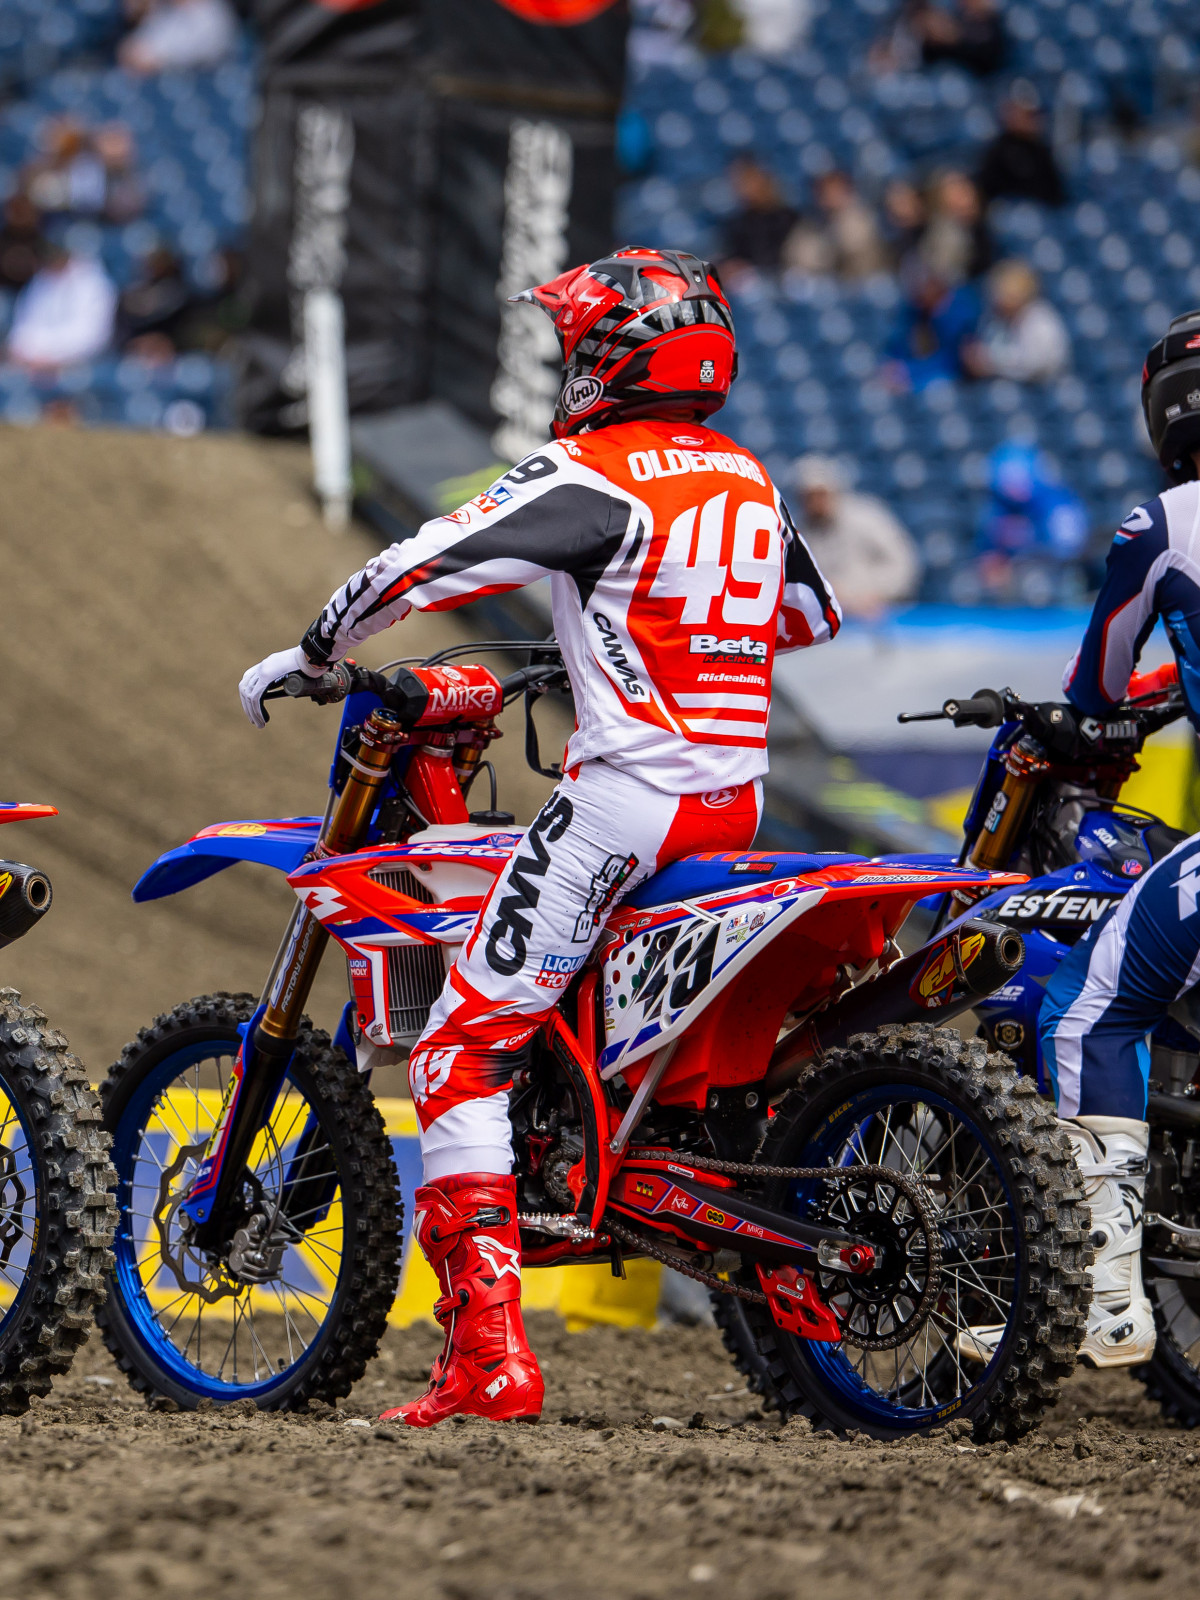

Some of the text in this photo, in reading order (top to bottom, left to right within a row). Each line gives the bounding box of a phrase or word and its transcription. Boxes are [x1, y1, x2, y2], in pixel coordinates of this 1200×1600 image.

[700, 369, 715, 378] DOT
[567, 380, 596, 407] Arai
[502, 455, 559, 484] 9
[627, 448, 766, 488] OLDENBURG
[649, 490, 783, 626] 49
[593, 612, 645, 697] CANVAS
[690, 634, 768, 655] Beta
[704, 654, 754, 664] RACING
[696, 673, 766, 687] Rideability
[1123, 858, 1139, 874] VP
[281, 963, 302, 1013] FACTORY
[298, 916, 318, 963] SUSPEN
[349, 960, 367, 968] LIQUI
[350, 968, 367, 976] MOLY
[920, 932, 986, 997] FMF
[408, 1044, 465, 1106] 49
[828, 1100, 854, 1124] EXCEL
[636, 1181, 654, 1196] TM
[672, 1194, 689, 1210] Kite
[936, 1397, 962, 1420] EXCEL
